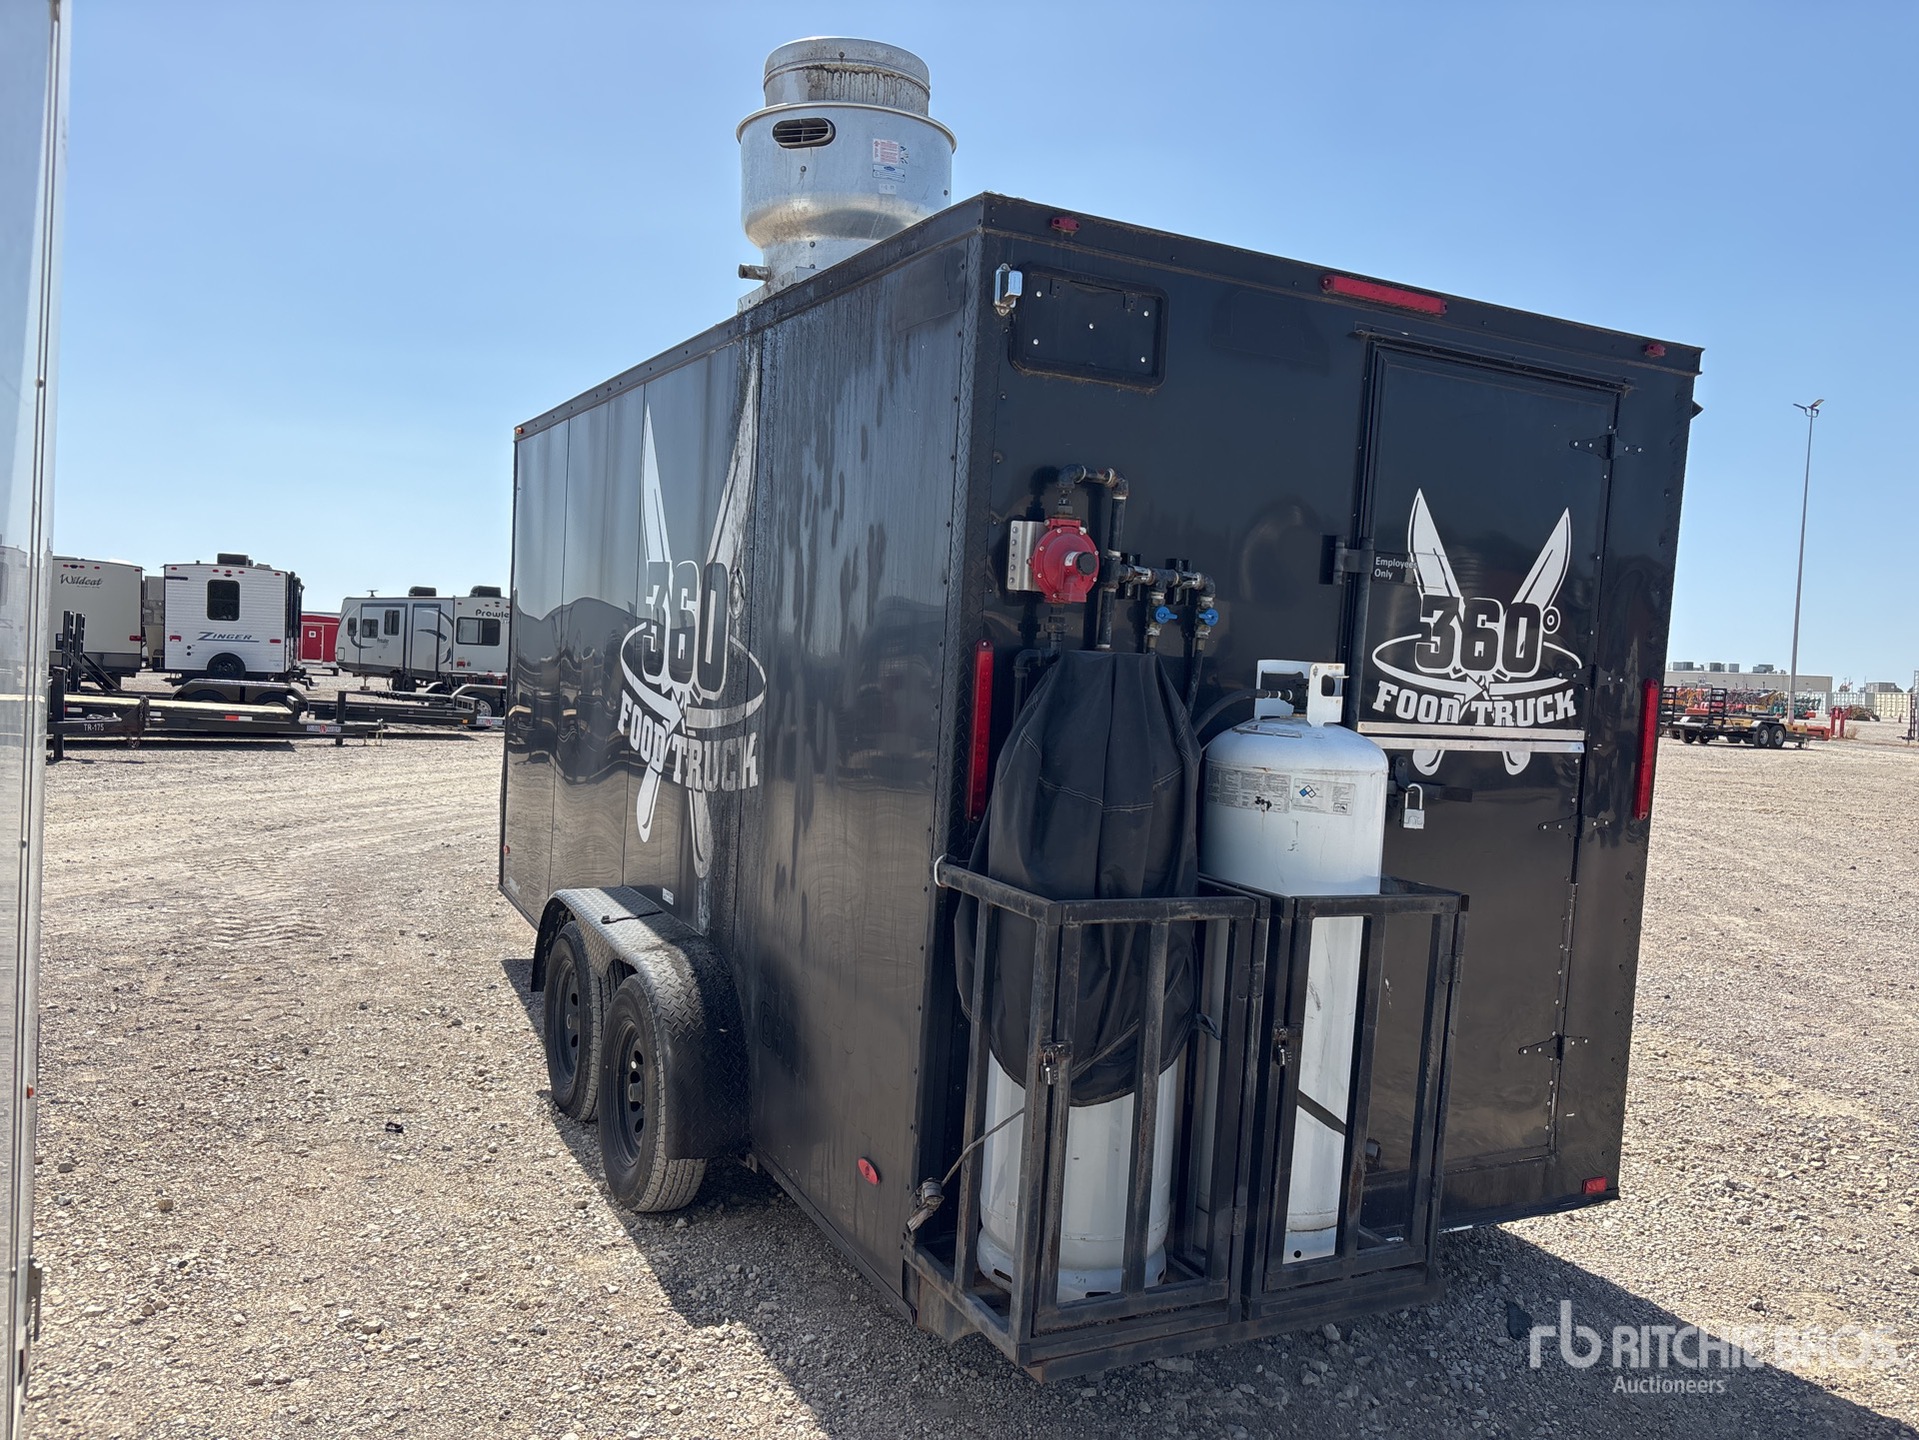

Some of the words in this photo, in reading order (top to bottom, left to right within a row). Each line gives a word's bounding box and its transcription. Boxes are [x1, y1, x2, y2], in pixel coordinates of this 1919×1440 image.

[1375, 557, 1418, 570] Employees
[60, 574, 103, 586] Wildcat
[1374, 568, 1393, 580] Only
[475, 609, 510, 618] Prowle
[1372, 680, 1463, 724] FOOD
[1470, 688, 1577, 727] TRUCK
[84, 724, 105, 732] TR-175
[617, 690, 668, 774] FOOD
[671, 732, 759, 793] TRUCK
